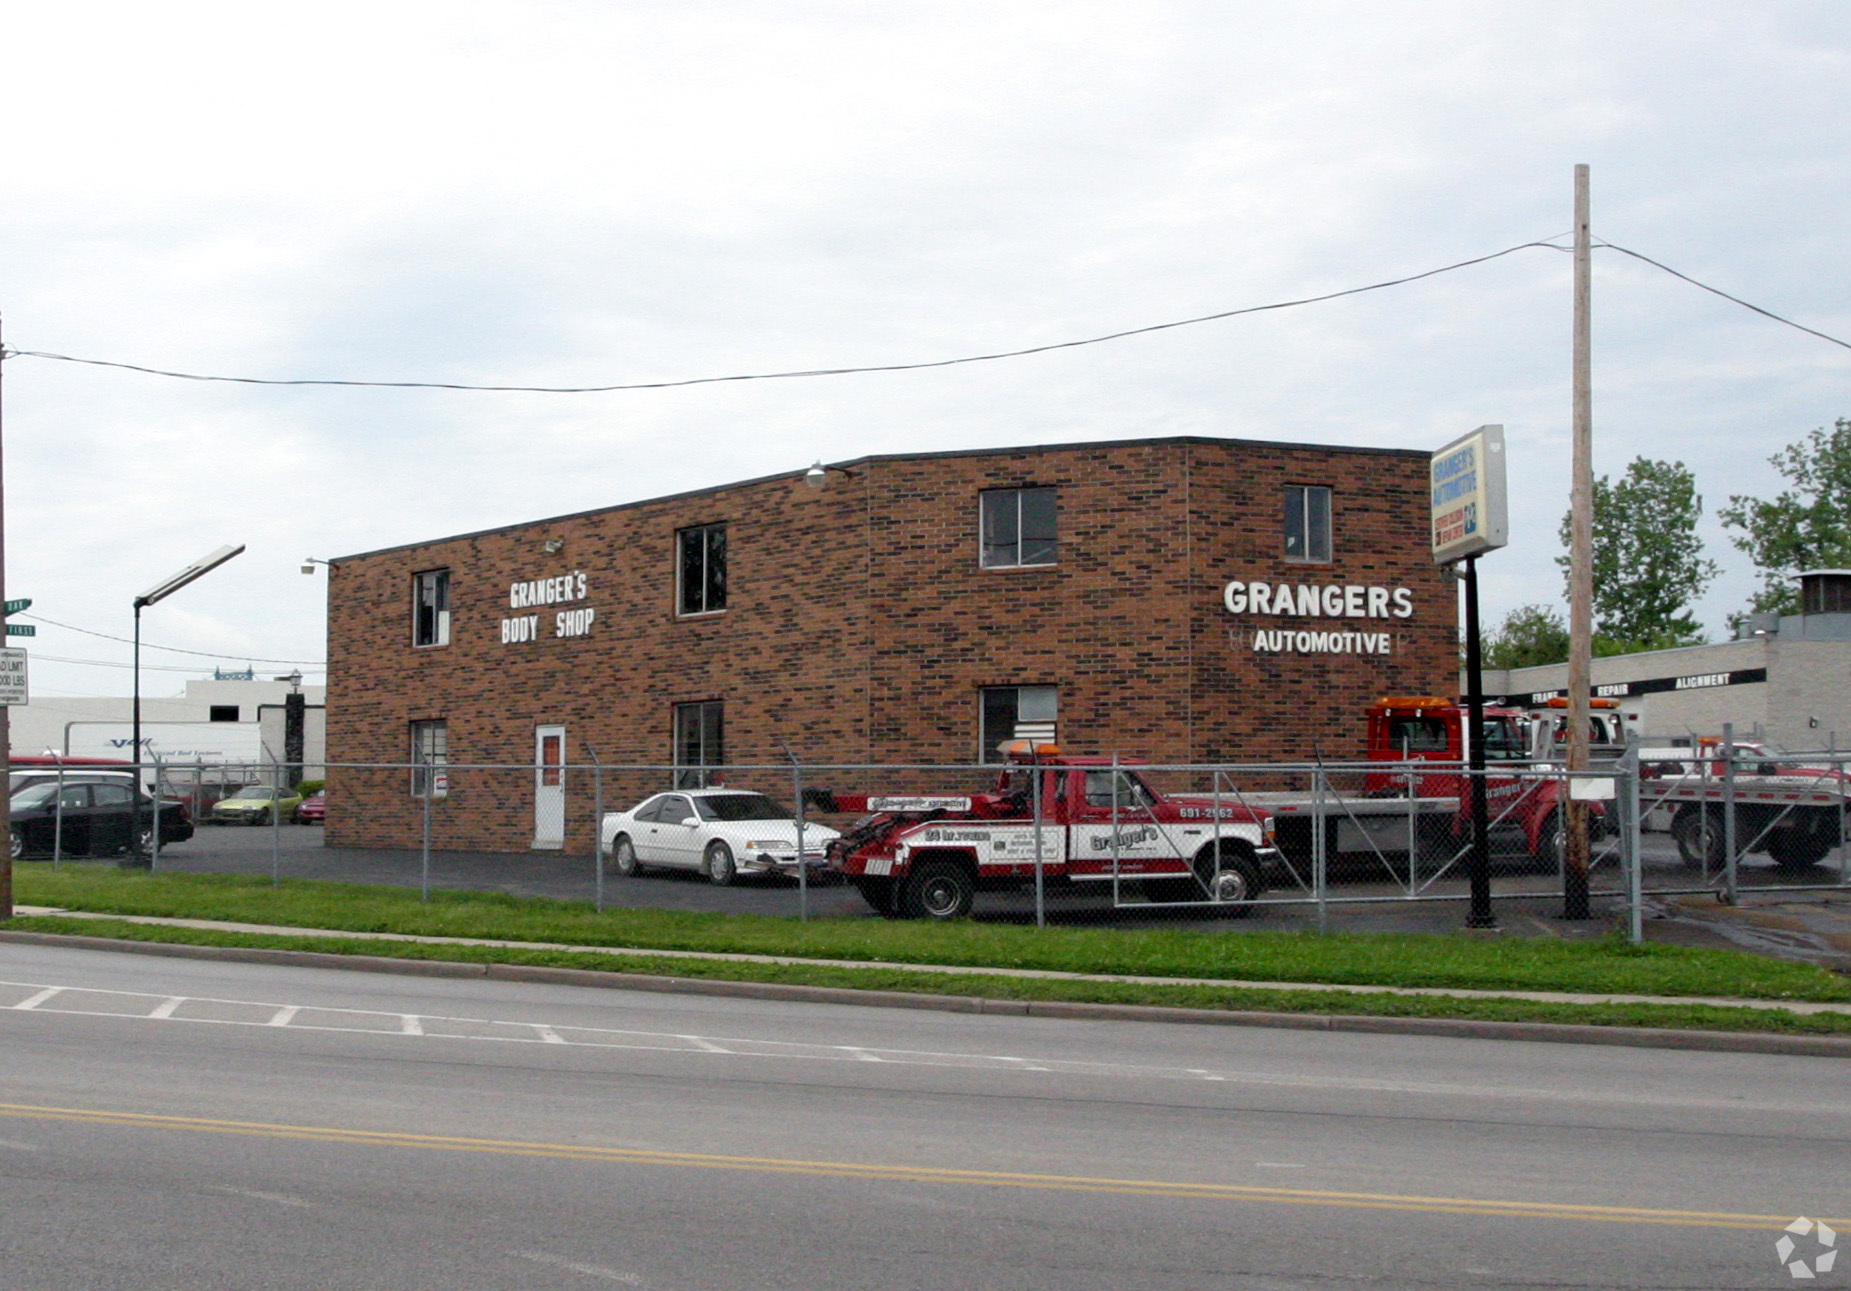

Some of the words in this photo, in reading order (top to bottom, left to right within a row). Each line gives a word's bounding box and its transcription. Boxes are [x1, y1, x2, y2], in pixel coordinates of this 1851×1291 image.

[510, 570, 587, 608] GRANGER'S
[1224, 581, 1413, 618] GRANGERS
[9, 626, 33, 636] FIRST
[502, 615, 538, 644] BODY
[556, 608, 594, 638] SHOP
[1254, 630, 1390, 654] AUTOMOTIVE
[13, 675, 25, 686] LBS
[1675, 673, 1730, 689] ALIGNMENT
[1597, 684, 1629, 697] REPAIR
[925, 829, 941, 841] 24
